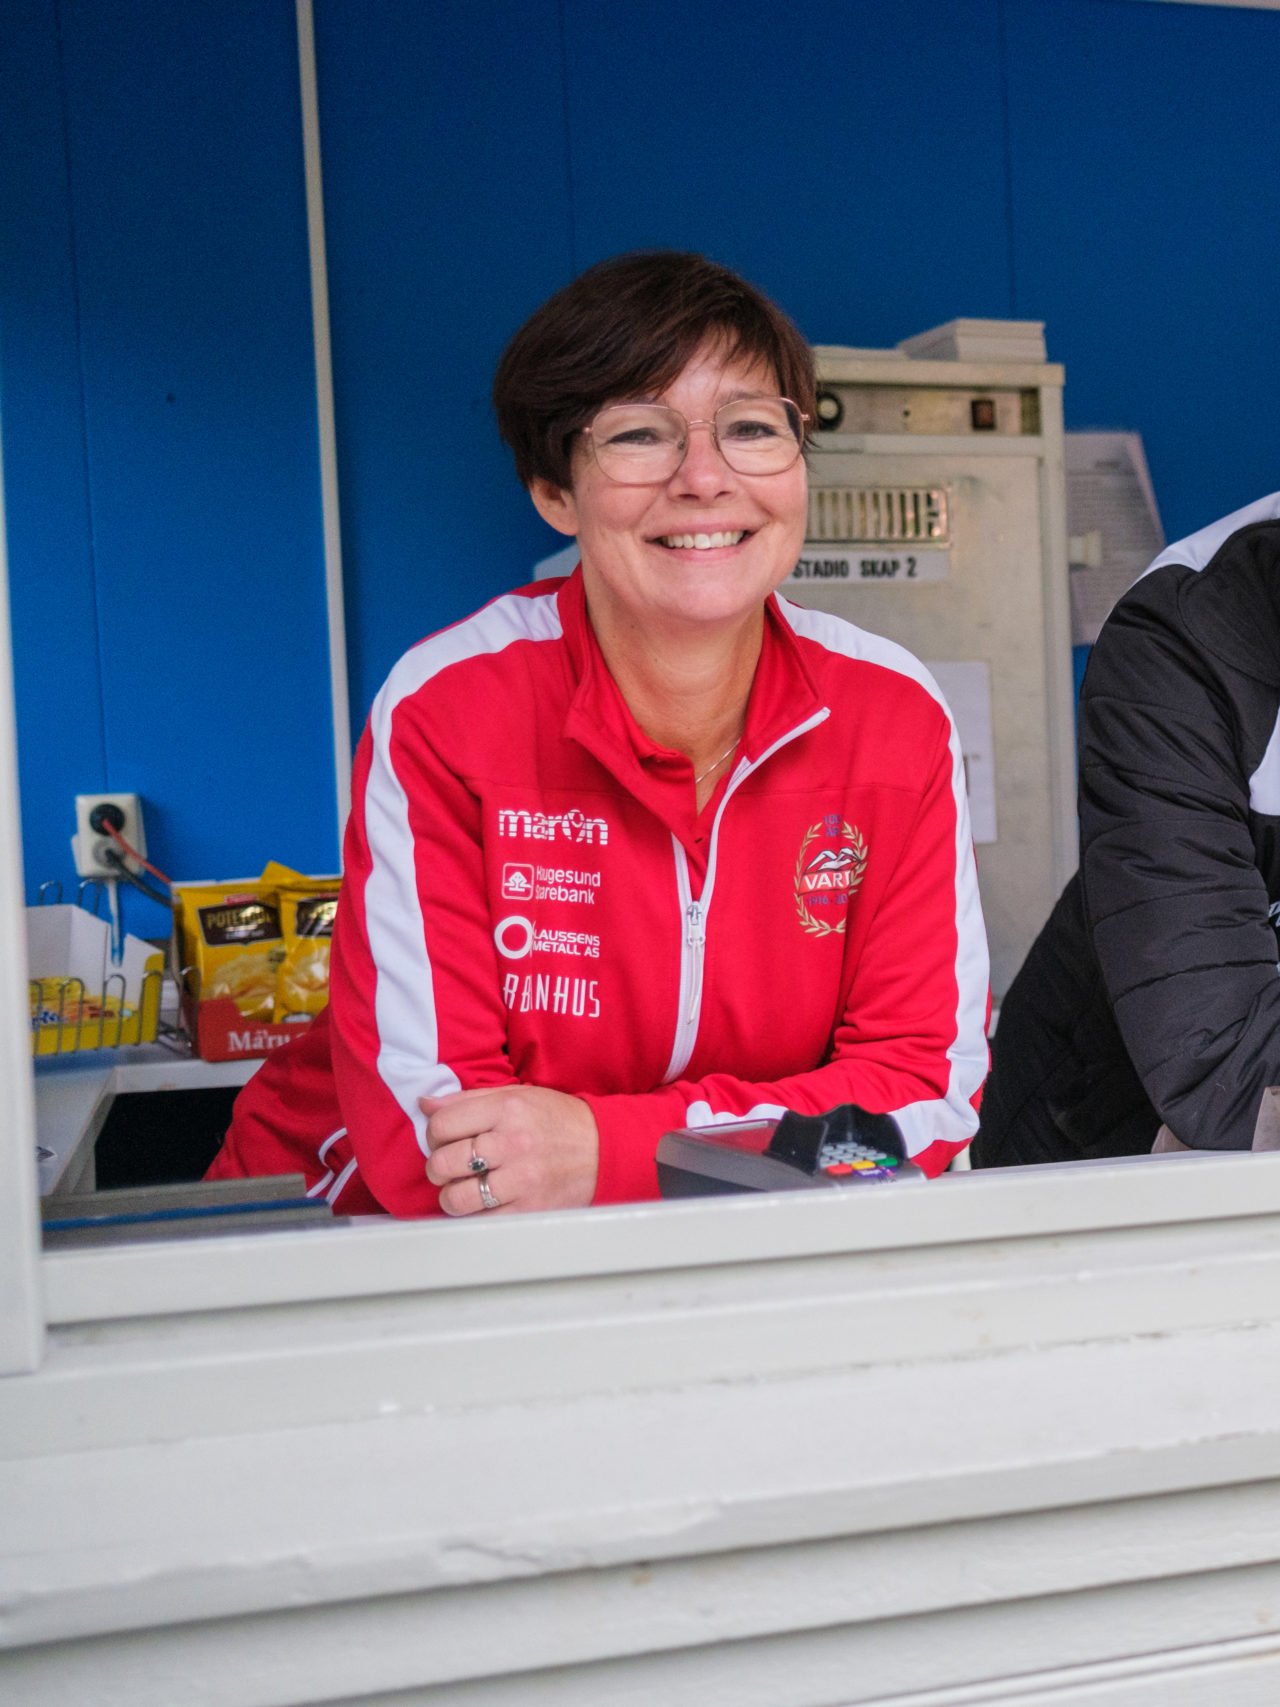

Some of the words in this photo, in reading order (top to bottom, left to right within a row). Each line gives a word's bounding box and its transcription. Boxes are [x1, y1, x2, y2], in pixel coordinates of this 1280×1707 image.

[860, 558, 900, 578] SKAP
[907, 556, 918, 579] 2
[533, 940, 581, 956] METALL
[584, 947, 600, 958] AS
